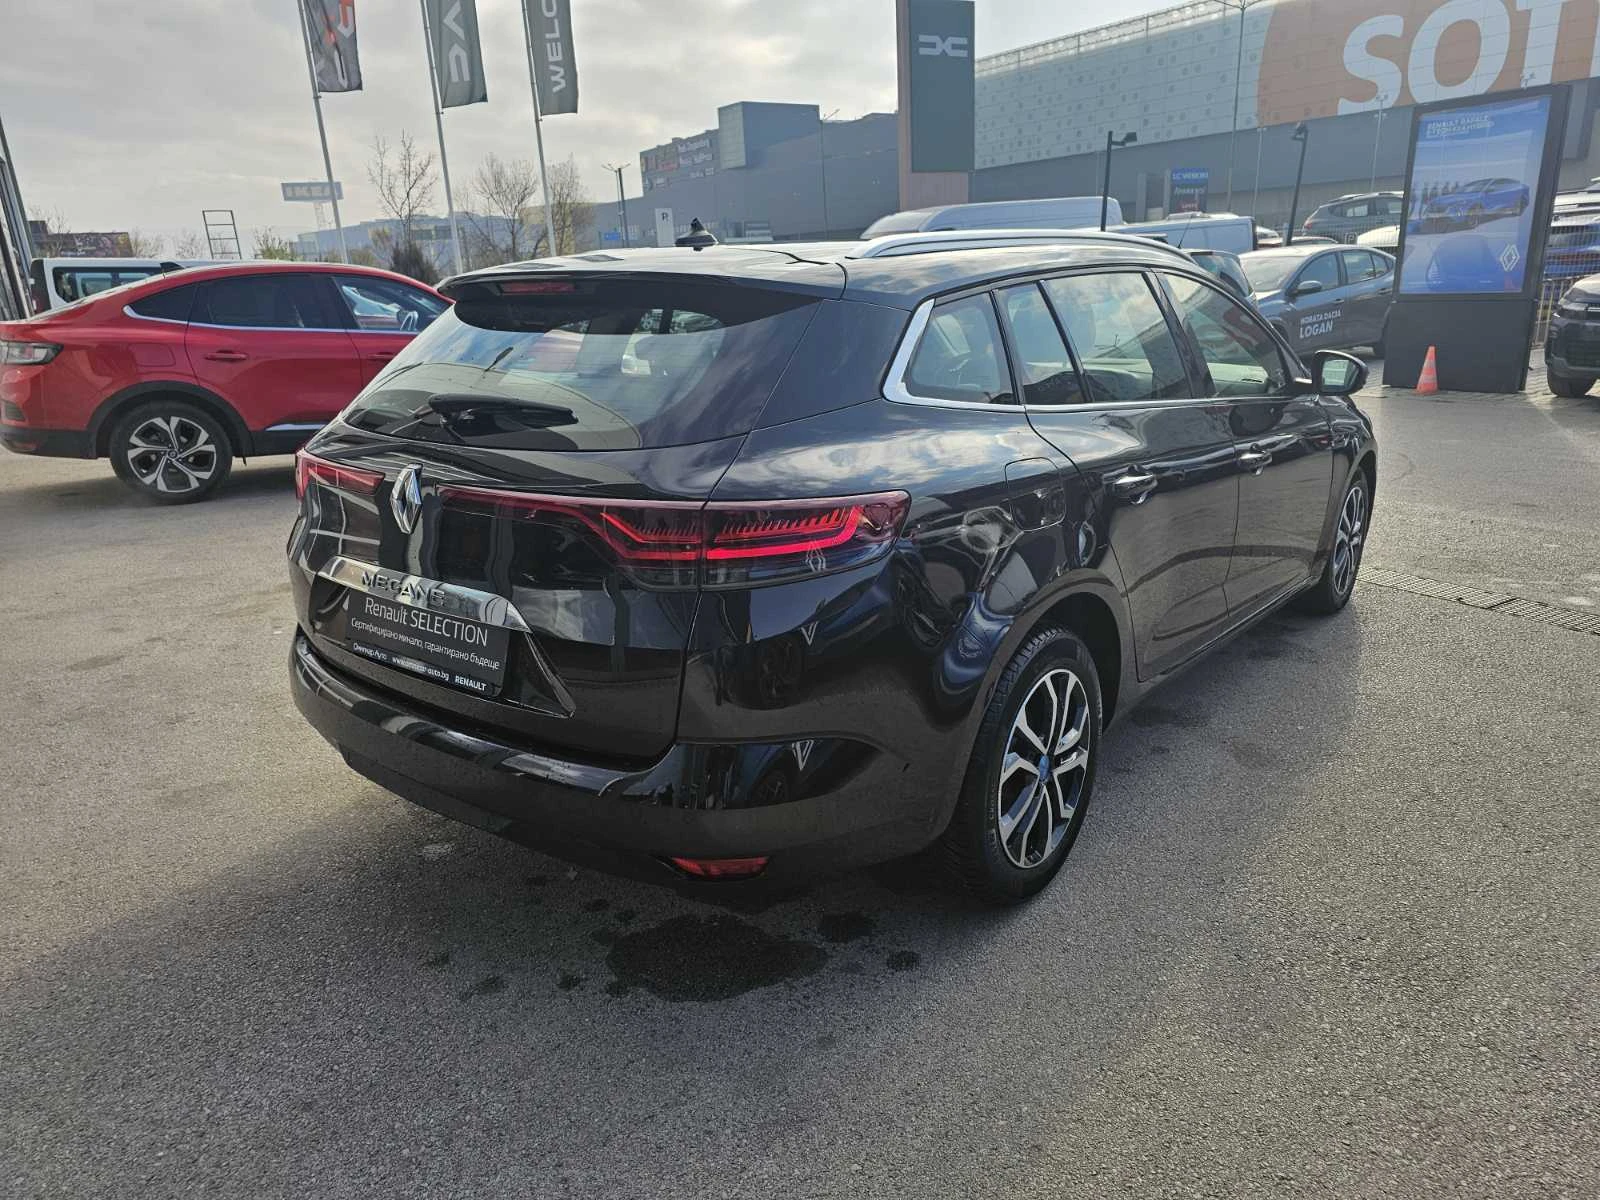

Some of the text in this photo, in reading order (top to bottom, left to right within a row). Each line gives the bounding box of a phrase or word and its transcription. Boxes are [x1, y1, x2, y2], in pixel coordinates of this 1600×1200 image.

[1299, 319, 1333, 339] LOGAN
[365, 597, 488, 647] Renault SELECTION
[424, 640, 469, 661] гарантирано
[469, 651, 500, 670] бъдеще
[455, 675, 488, 692] RENAULT
